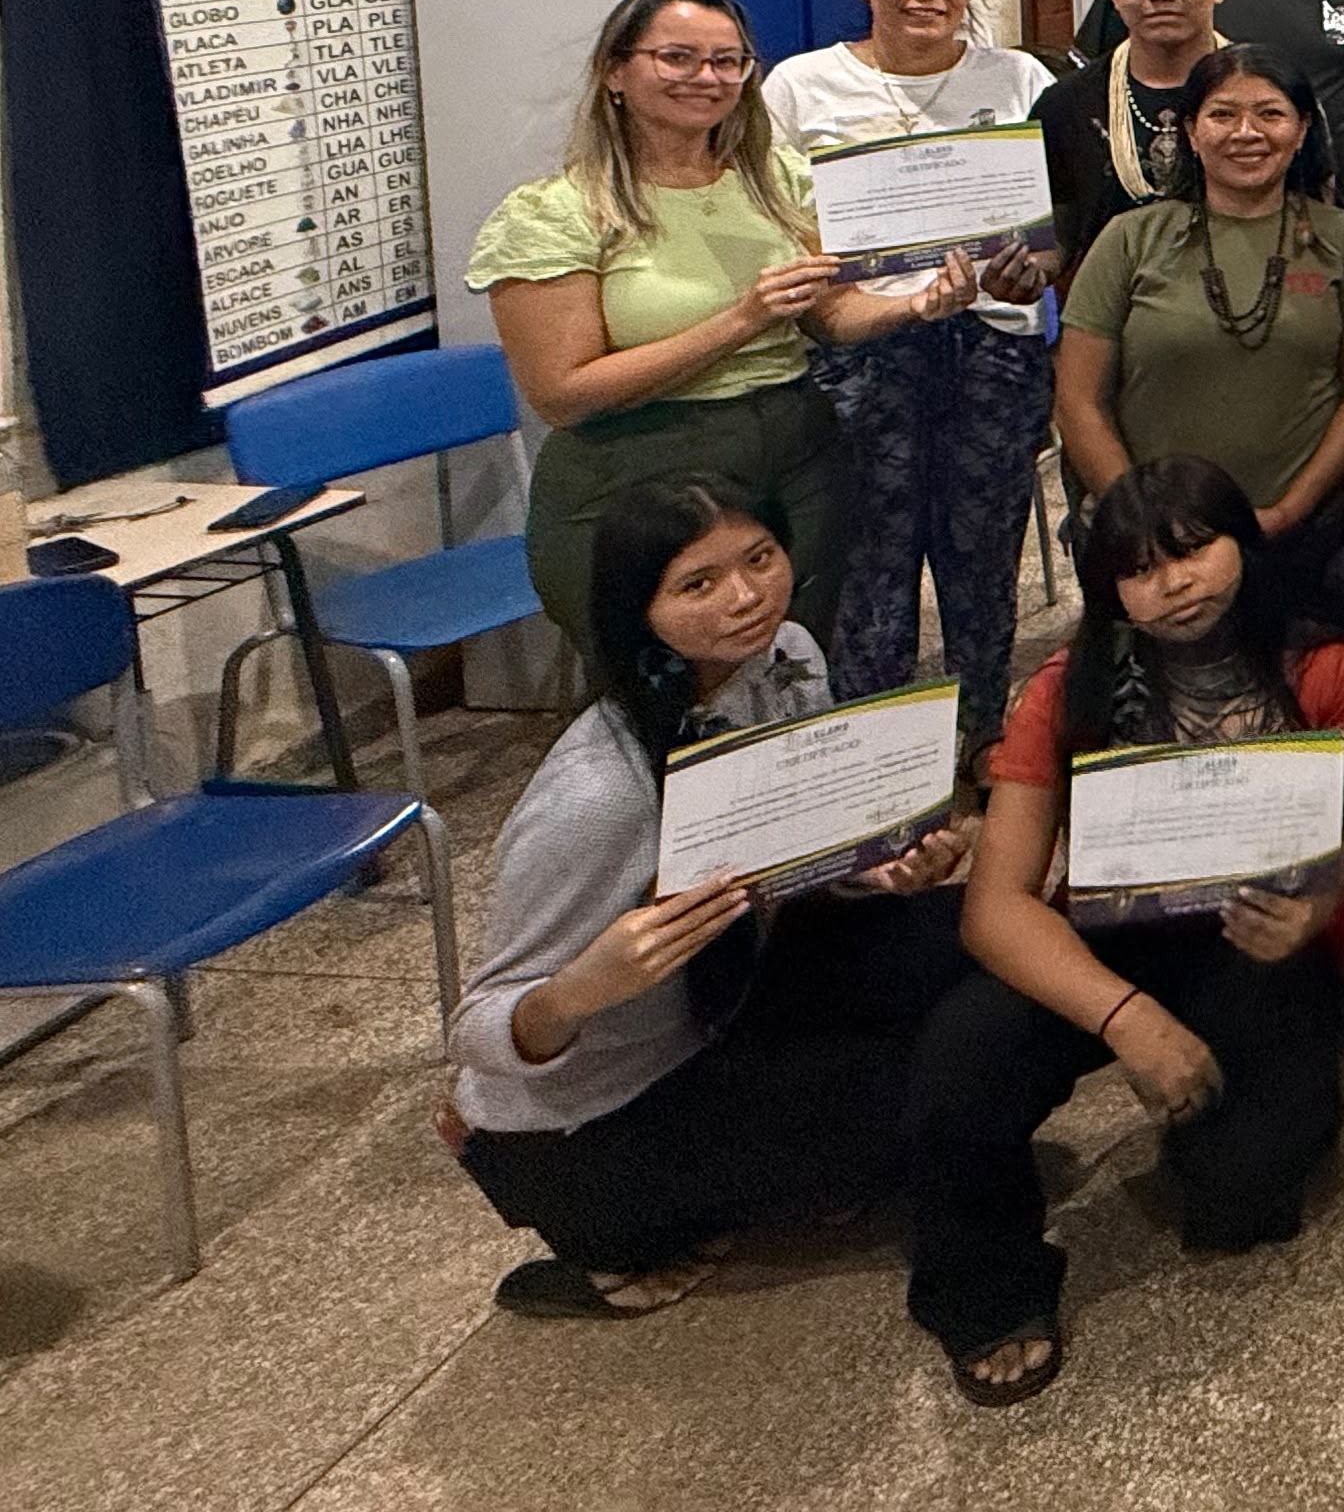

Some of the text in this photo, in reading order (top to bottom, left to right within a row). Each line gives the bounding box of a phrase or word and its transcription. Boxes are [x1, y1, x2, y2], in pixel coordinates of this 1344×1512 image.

[169, 5, 239, 29] GLOBO
[173, 8, 402, 54] PLACA PLA PLE
[314, 41, 355, 60] TLA
[369, 33, 405, 52] TLE
[178, 56, 407, 108] VLADIMIR VLA VLE
[320, 89, 362, 109] CHA
[374, 78, 411, 98] CHE
[322, 110, 364, 132] NHA
[376, 101, 412, 121] NHE
[191, 125, 413, 186] COELHO LHA LHE
[327, 158, 370, 180] GUA
[378, 147, 415, 169] GUE
[200, 171, 411, 237] ANJO AN EN
[333, 208, 360, 227] AR
[388, 195, 412, 213] ER
[206, 259, 275, 290] ESCADA
[335, 232, 363, 250] AS
[210, 240, 417, 313] ALFACE AL EL
[213, 306, 282, 339] NUVENS
[336, 276, 372, 298] ANS
[216, 326, 294, 365] BOMBOM
[342, 301, 367, 321] AM
